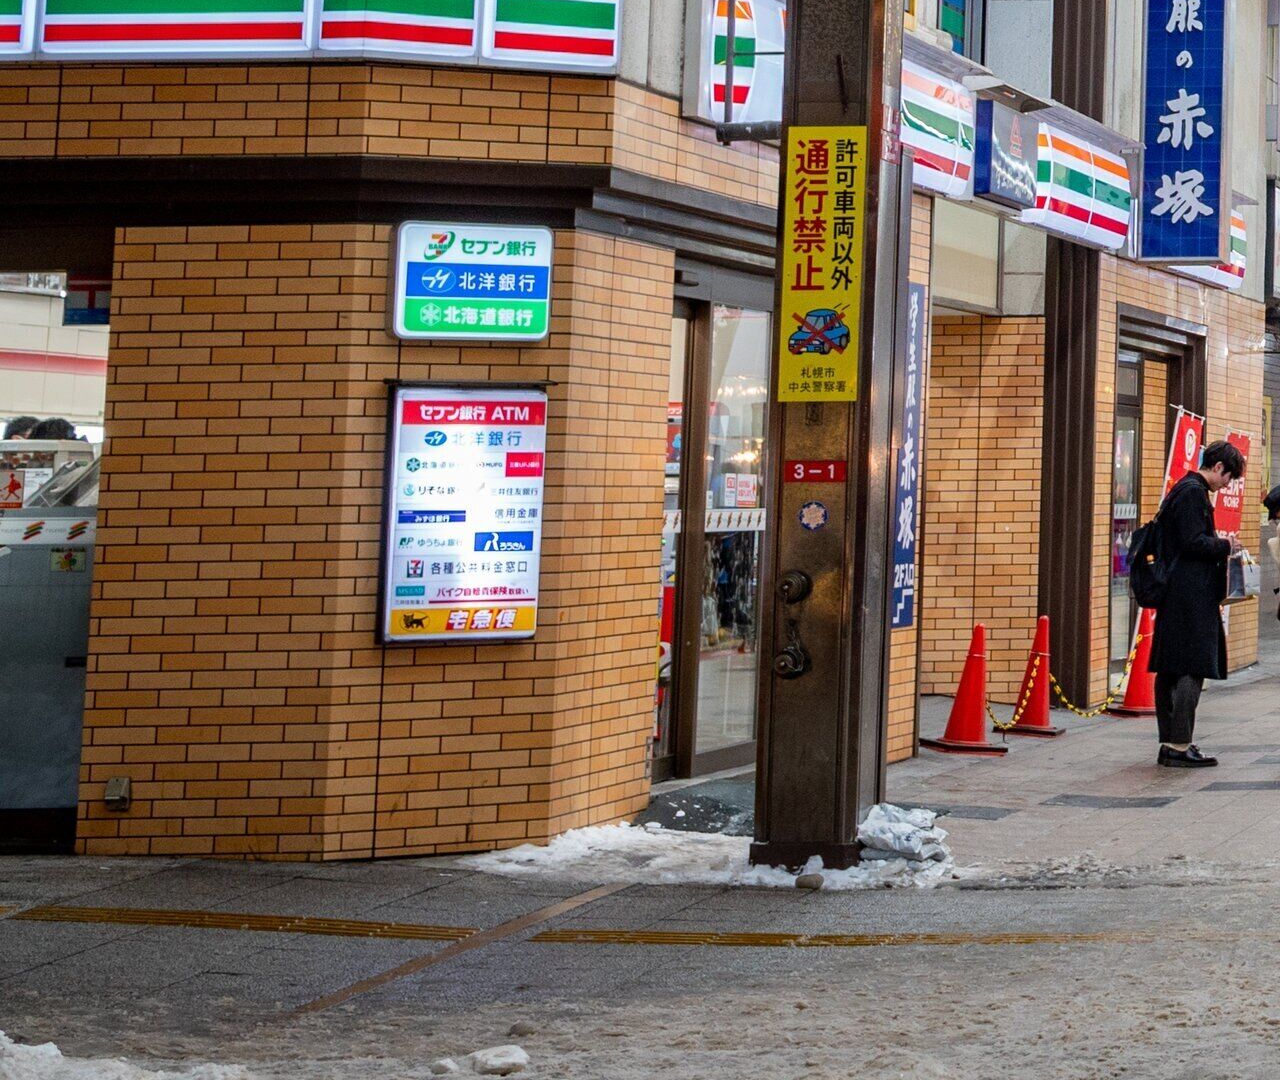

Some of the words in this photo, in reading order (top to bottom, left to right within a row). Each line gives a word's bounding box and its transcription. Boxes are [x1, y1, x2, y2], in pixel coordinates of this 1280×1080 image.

[790, 138, 830, 292] 通行禁止
[830, 138, 859, 291] 許可車両以外
[460, 238, 537, 257] セブン銀行
[458, 271, 536, 293] 北洋銀行
[442, 305, 534, 328] 北海道銀行
[801, 366, 835, 379] 札幌市
[788, 380, 848, 393] 中央警察署
[419, 404, 488, 420] セブン銀行
[491, 405, 530, 419] ATM
[452, 430, 523, 447] 北洋銀行
[494, 508, 539, 519] 信用金庫
[446, 608, 517, 630] 宅急便
